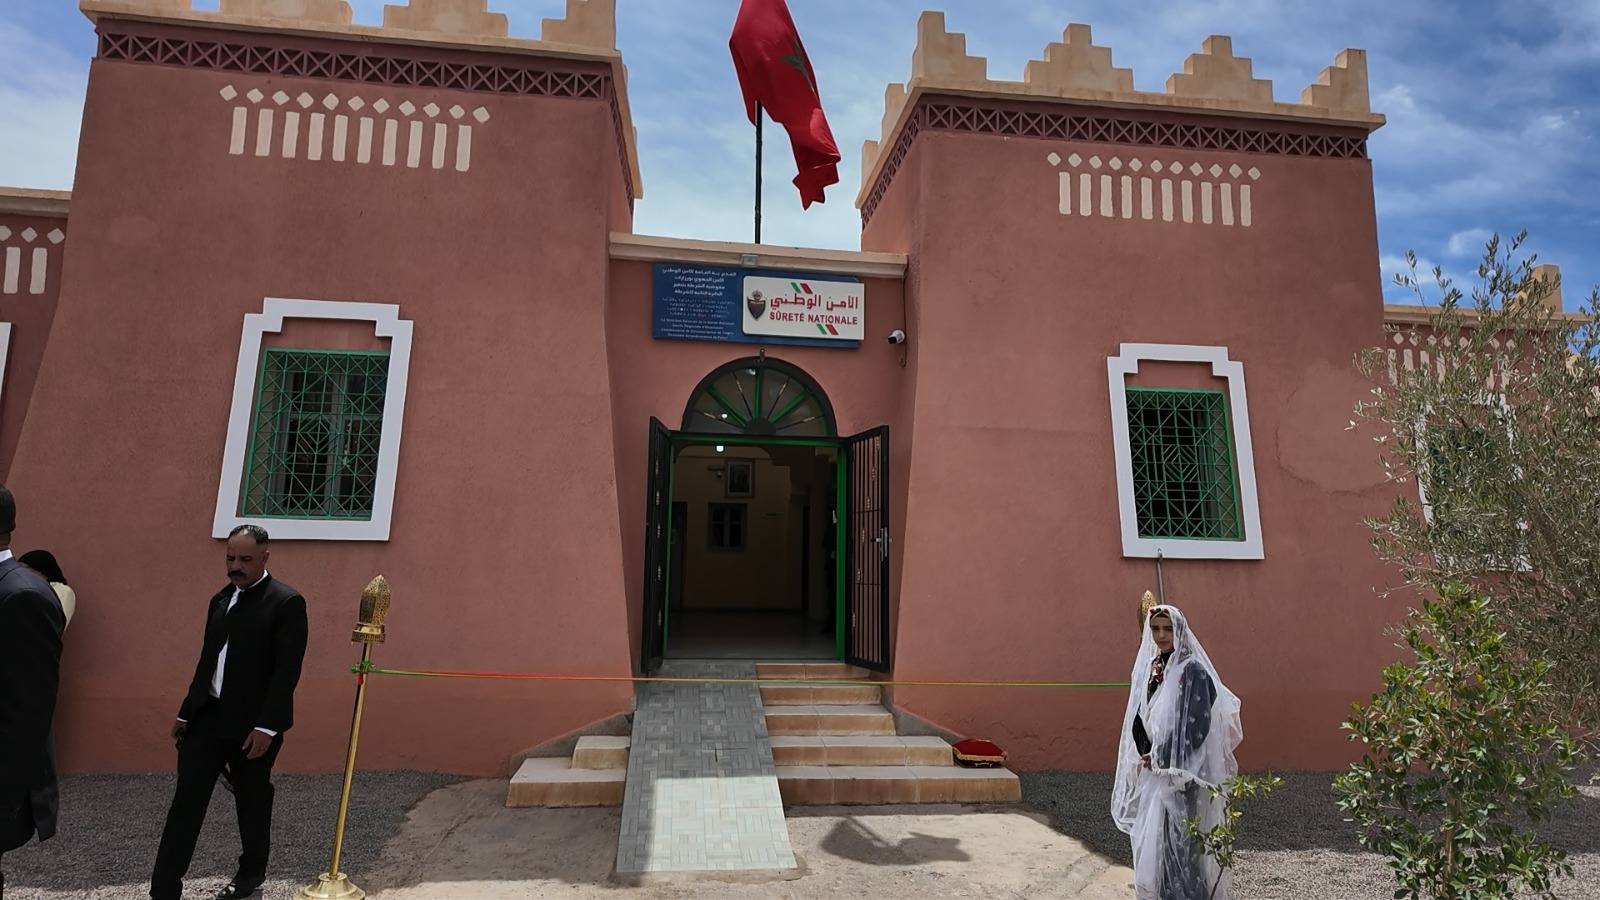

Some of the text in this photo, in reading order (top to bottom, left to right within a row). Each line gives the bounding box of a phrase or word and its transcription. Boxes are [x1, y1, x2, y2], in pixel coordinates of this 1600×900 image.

[770, 292, 821, 311] الوطني
[769, 310, 858, 325] SÛRETÉ NATIONALE
